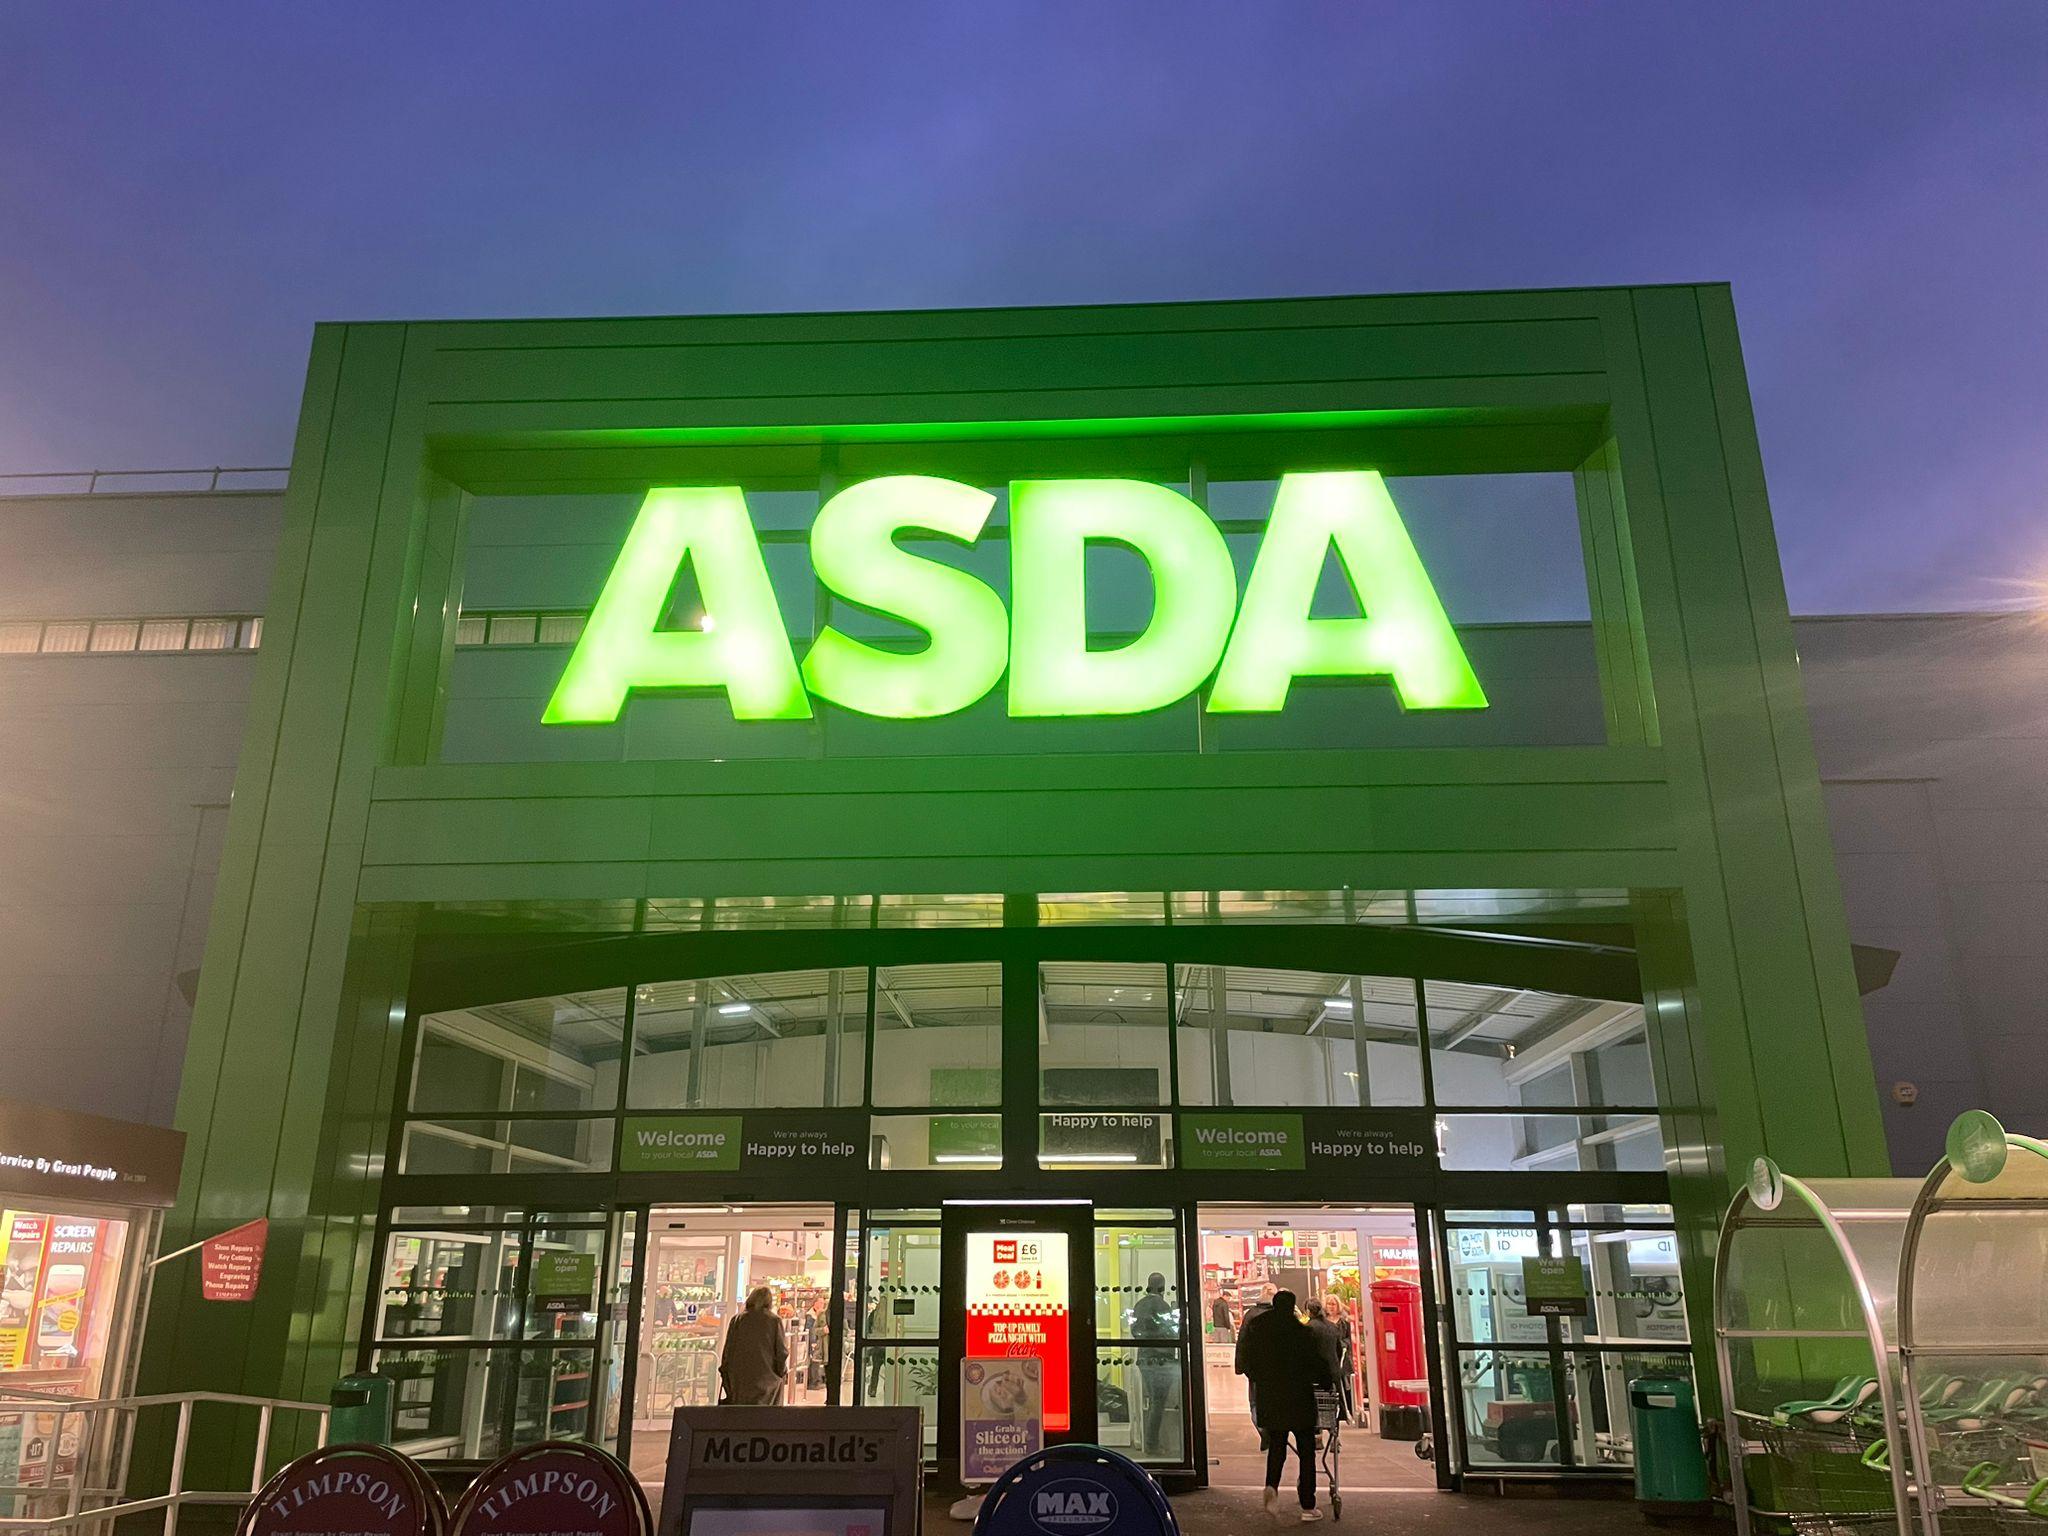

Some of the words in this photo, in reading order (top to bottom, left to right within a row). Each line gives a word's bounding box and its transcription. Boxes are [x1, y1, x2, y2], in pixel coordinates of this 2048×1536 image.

[541, 469, 1489, 724] ASDA
[1052, 1115, 1098, 1129] Happy
[1102, 1116, 1118, 1127] to
[1121, 1115, 1153, 1129] help
[637, 1130, 726, 1146] Welcome
[773, 1130, 798, 1139] We're
[799, 1130, 828, 1139] always
[1195, 1128, 1288, 1144] Welcome
[1336, 1129, 1362, 1138] We're
[1364, 1129, 1394, 1139] always
[747, 1142, 797, 1158] Happy
[801, 1144, 817, 1155] to
[822, 1142, 855, 1157] help
[1213, 1150, 1234, 1158] your
[1236, 1148, 1257, 1156] local
[1311, 1142, 1362, 1157] Happy
[1367, 1143, 1384, 1155] to
[1389, 1141, 1424, 1157] help
[641, 1151, 649, 1159] to
[652, 1152, 672, 1160] your
[674, 1151, 694, 1159] local
[36, 1158, 51, 1174] By
[53, 1160, 82, 1176] Great
[83, 1164, 117, 1180] People
[14, 1221, 38, 1230] Watch
[12, 1230, 40, 1239] Repairs
[53, 1225, 96, 1238] SCREEN
[1496, 1229, 1534, 1237] PHOTO
[51, 1242, 94, 1253] REPAIRS
[231, 1244, 253, 1252] Repairs
[996, 1244, 1015, 1252] Meal
[1022, 1244, 1037, 1255] £6
[1498, 1240, 1511, 1250] ID
[231, 1254, 252, 1262] Cutting
[1539, 1258, 1566, 1266] We're
[228, 1263, 251, 1271] Repairs
[555, 1265, 577, 1273] open
[1541, 1267, 1565, 1275] open
[219, 1272, 250, 1281] Engraving
[205, 1281, 224, 1289] Phone
[225, 1282, 249, 1290] Repairs
[1017, 1322, 1041, 1333] FAMILY
[988, 1333, 1007, 1343] PIZZA
[1008, 1333, 1028, 1343] NIGHT
[1028, 1333, 1046, 1343] WITH
[995, 1425, 1015, 1433] Grab
[976, 1430, 1011, 1444] Slice
[1012, 1430, 1029, 1444] of
[703, 1435, 879, 1464] McDonald's
[979, 1446, 994, 1455] the
[995, 1445, 1027, 1455] action!
[270, 1472, 406, 1520] TIMPSON
[477, 1471, 617, 1520] TIMPSON
[1037, 1492, 1110, 1514] MAX
